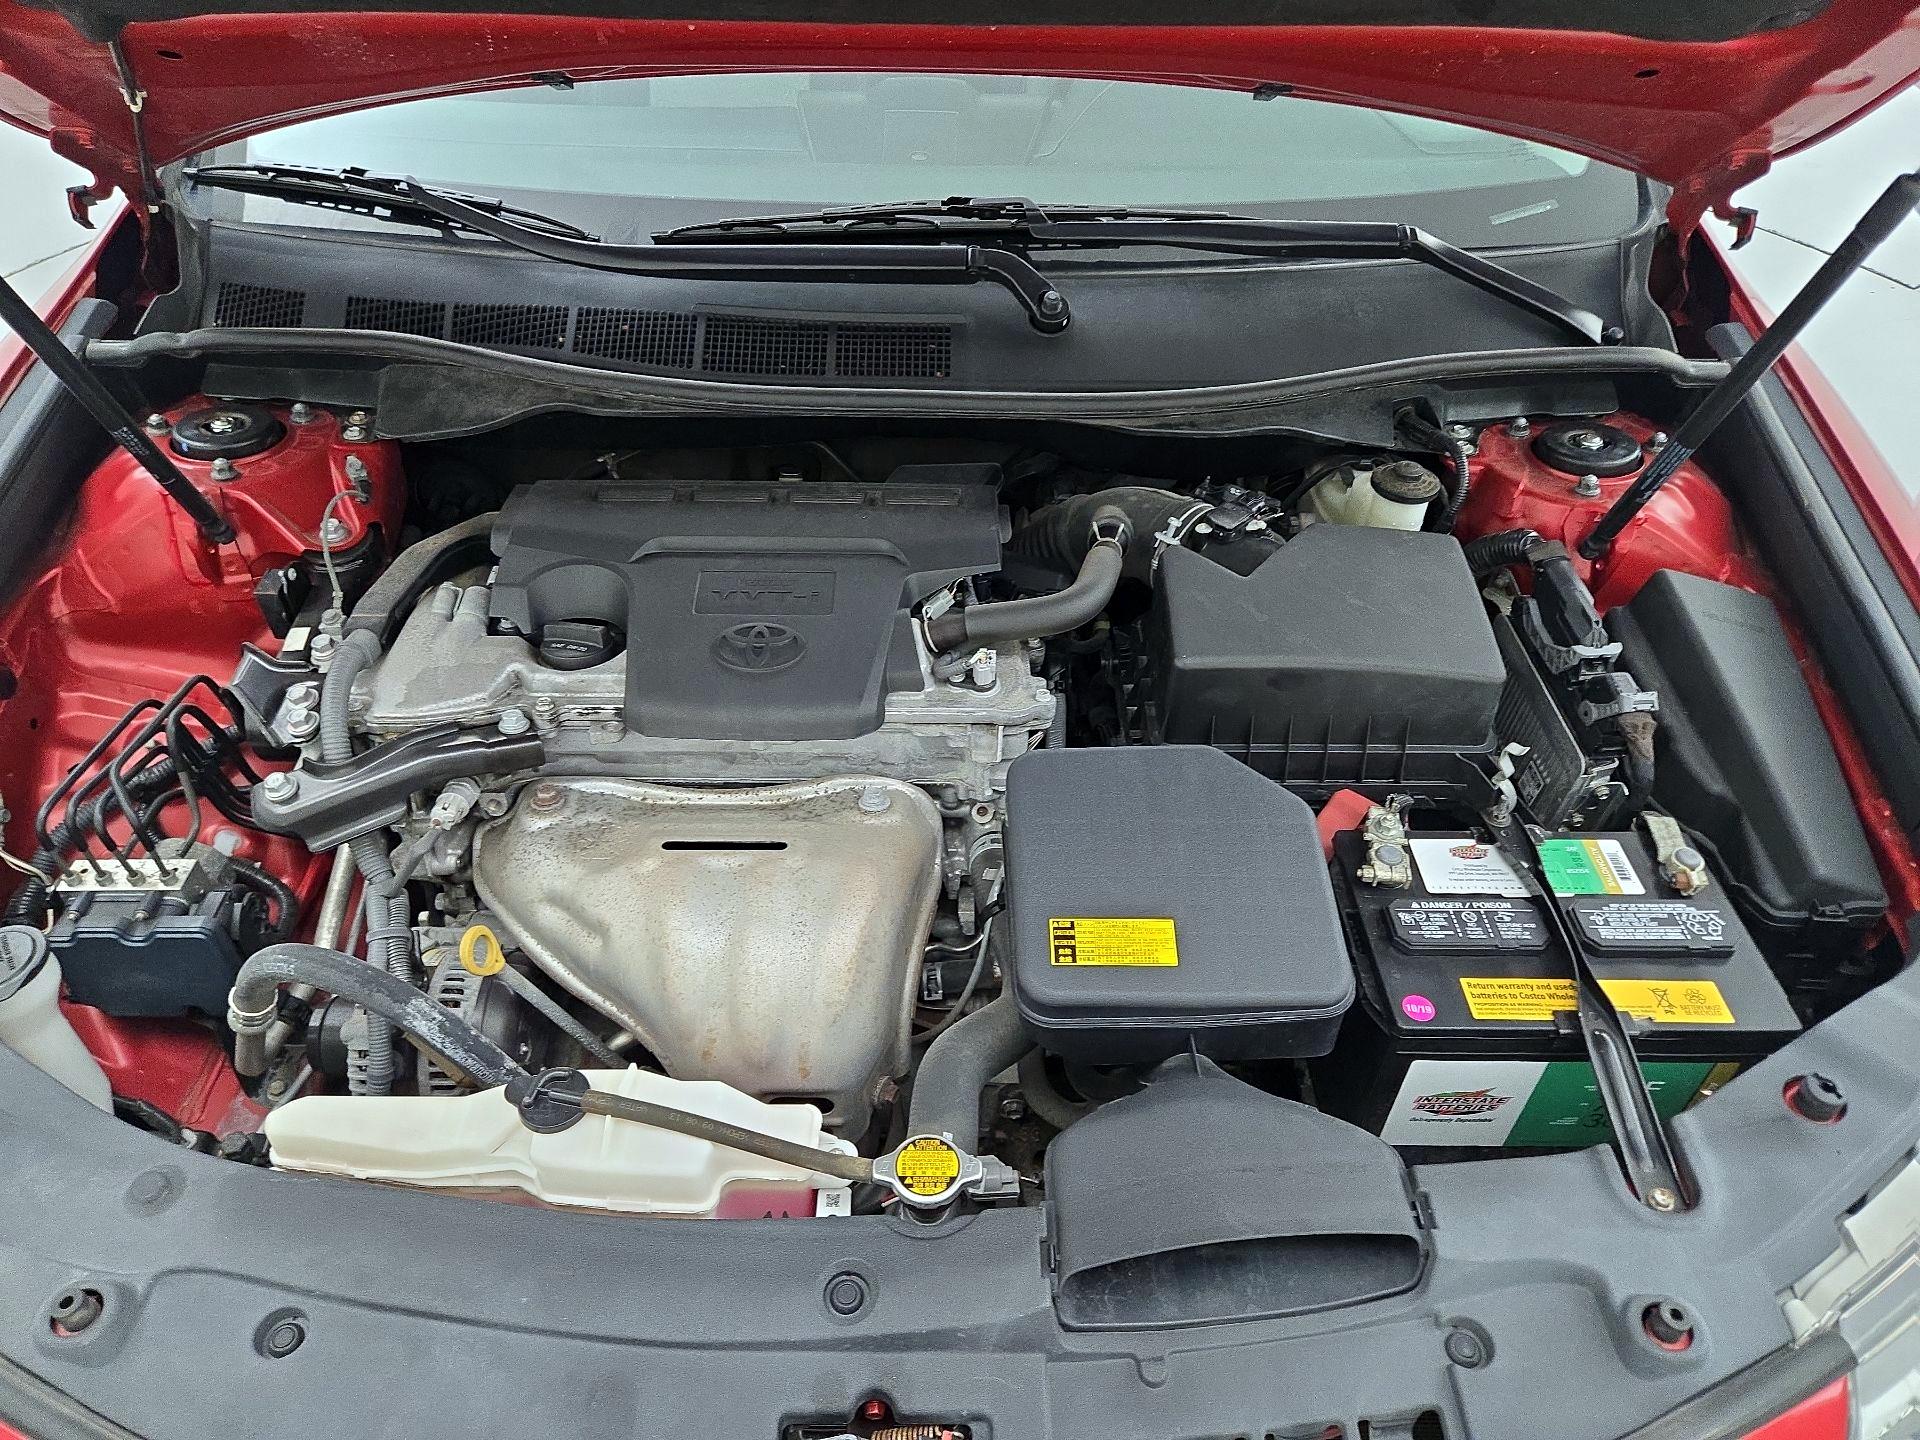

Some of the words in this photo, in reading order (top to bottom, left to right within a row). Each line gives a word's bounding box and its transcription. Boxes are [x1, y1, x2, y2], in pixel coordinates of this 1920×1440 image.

[1467, 982, 1495, 990] Return
[1497, 983, 1534, 991] warranty
[1471, 992, 1507, 1000] batteries
[1519, 992, 1545, 1000] Costco
[1405, 1003, 1432, 1013] 10/19
[1415, 1096, 1507, 1104] INTERSTATE
